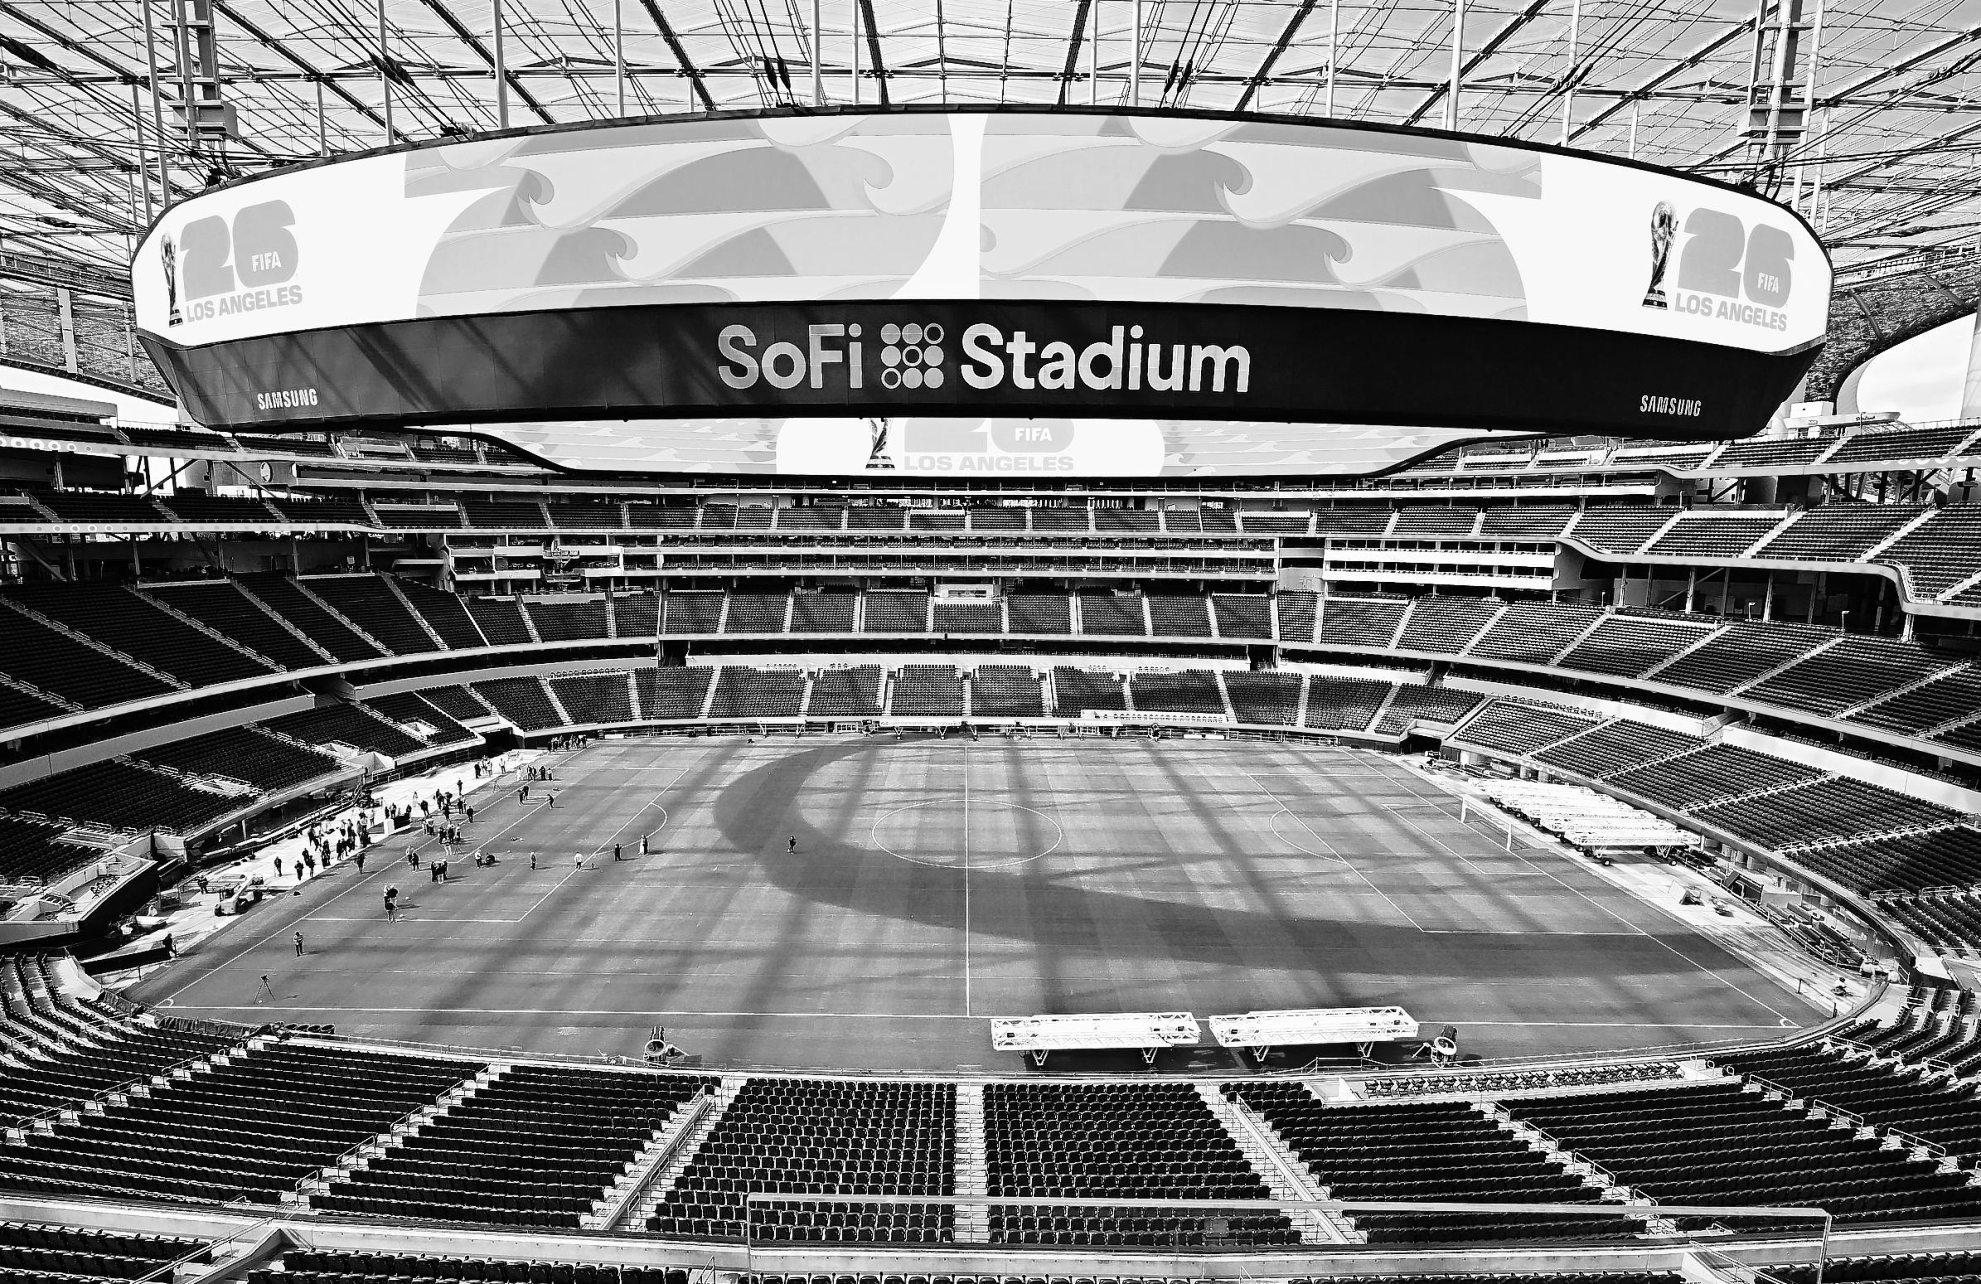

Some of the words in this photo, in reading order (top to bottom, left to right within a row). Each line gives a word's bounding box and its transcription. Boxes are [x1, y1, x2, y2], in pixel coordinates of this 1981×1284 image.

[180, 200, 299, 301] 26
[251, 251, 282, 272] FIFA
[1677, 207, 1795, 309] 26
[1757, 272, 1779, 294] FIFA
[186, 300, 215, 323] LOS
[218, 285, 303, 316] ANGELES
[1674, 293, 1713, 317] LOS
[1716, 301, 1787, 332] ANGELES
[717, 323, 863, 389] SoFi
[960, 323, 1251, 392] Stadium
[257, 388, 318, 410] SAMSUNG
[1639, 394, 1702, 417] SAMSUNG
[1014, 427, 1053, 442] FIFA
[904, 456, 953, 471] LOS
[958, 456, 1074, 472] ANGELES
